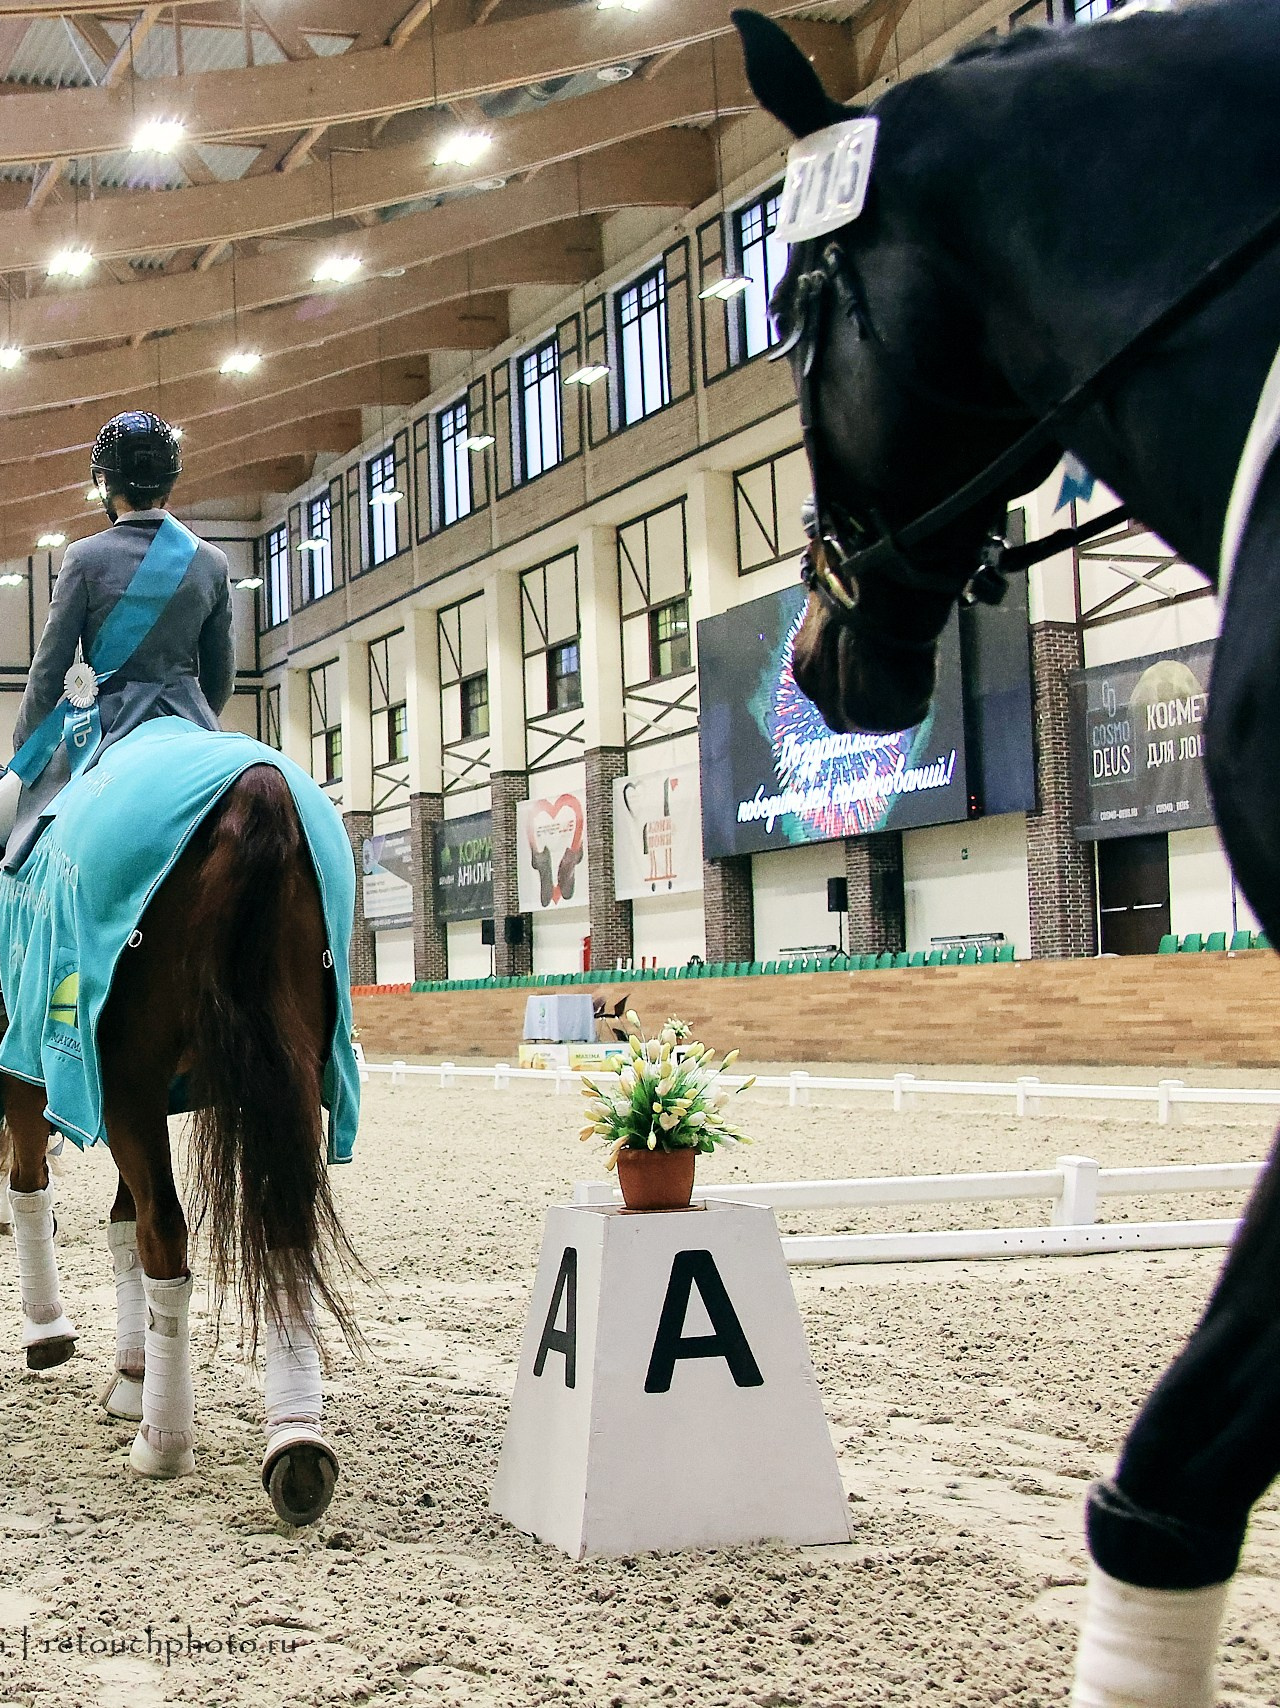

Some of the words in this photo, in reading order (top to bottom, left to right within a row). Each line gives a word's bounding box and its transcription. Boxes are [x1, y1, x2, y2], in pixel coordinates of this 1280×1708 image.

[1093, 721, 1130, 747] COSMO
[1093, 744, 1131, 779] DEUS
[1147, 739, 1175, 768] ДЛЯ
[533, 1246, 577, 1389] A
[644, 1249, 764, 1393] A
